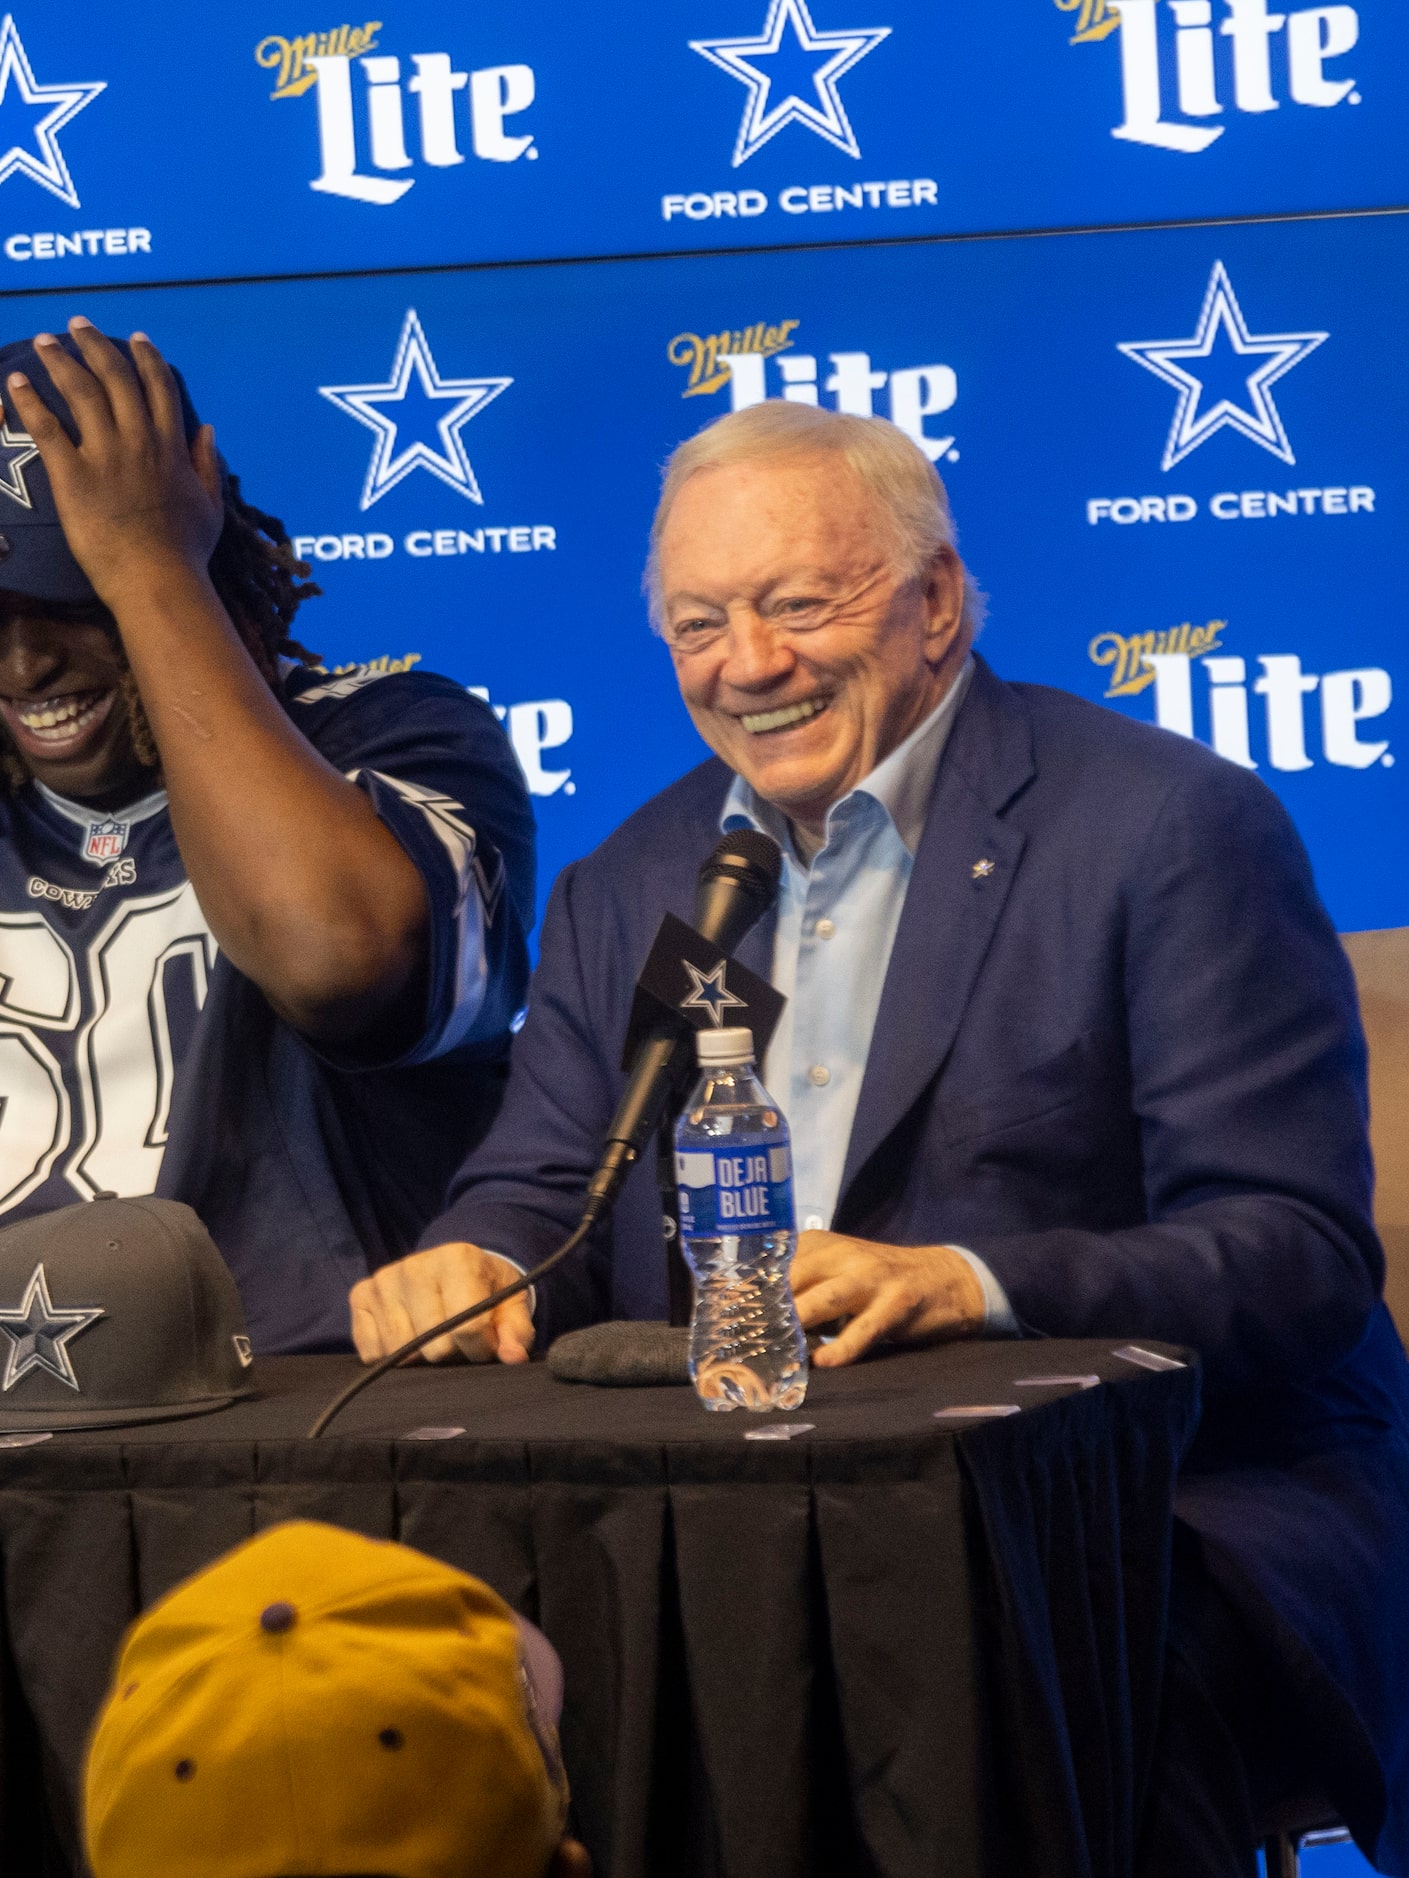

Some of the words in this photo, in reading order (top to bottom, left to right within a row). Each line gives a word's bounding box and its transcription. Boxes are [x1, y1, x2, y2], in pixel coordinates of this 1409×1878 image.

[256, 22, 384, 101] Miller
[662, 190, 768, 220] FORD
[779, 178, 938, 214] CENTER
[4, 227, 151, 261] CENTER
[669, 319, 800, 398] Miller
[1086, 495, 1198, 526] FORD
[1208, 486, 1375, 520] CENTER
[294, 533, 394, 561] FORD
[404, 525, 556, 557] CENTER
[1089, 619, 1228, 698] Miller
[89, 836, 120, 857] NFL
[717, 1156, 768, 1188] DEJA
[720, 1186, 771, 1219] BLUE
